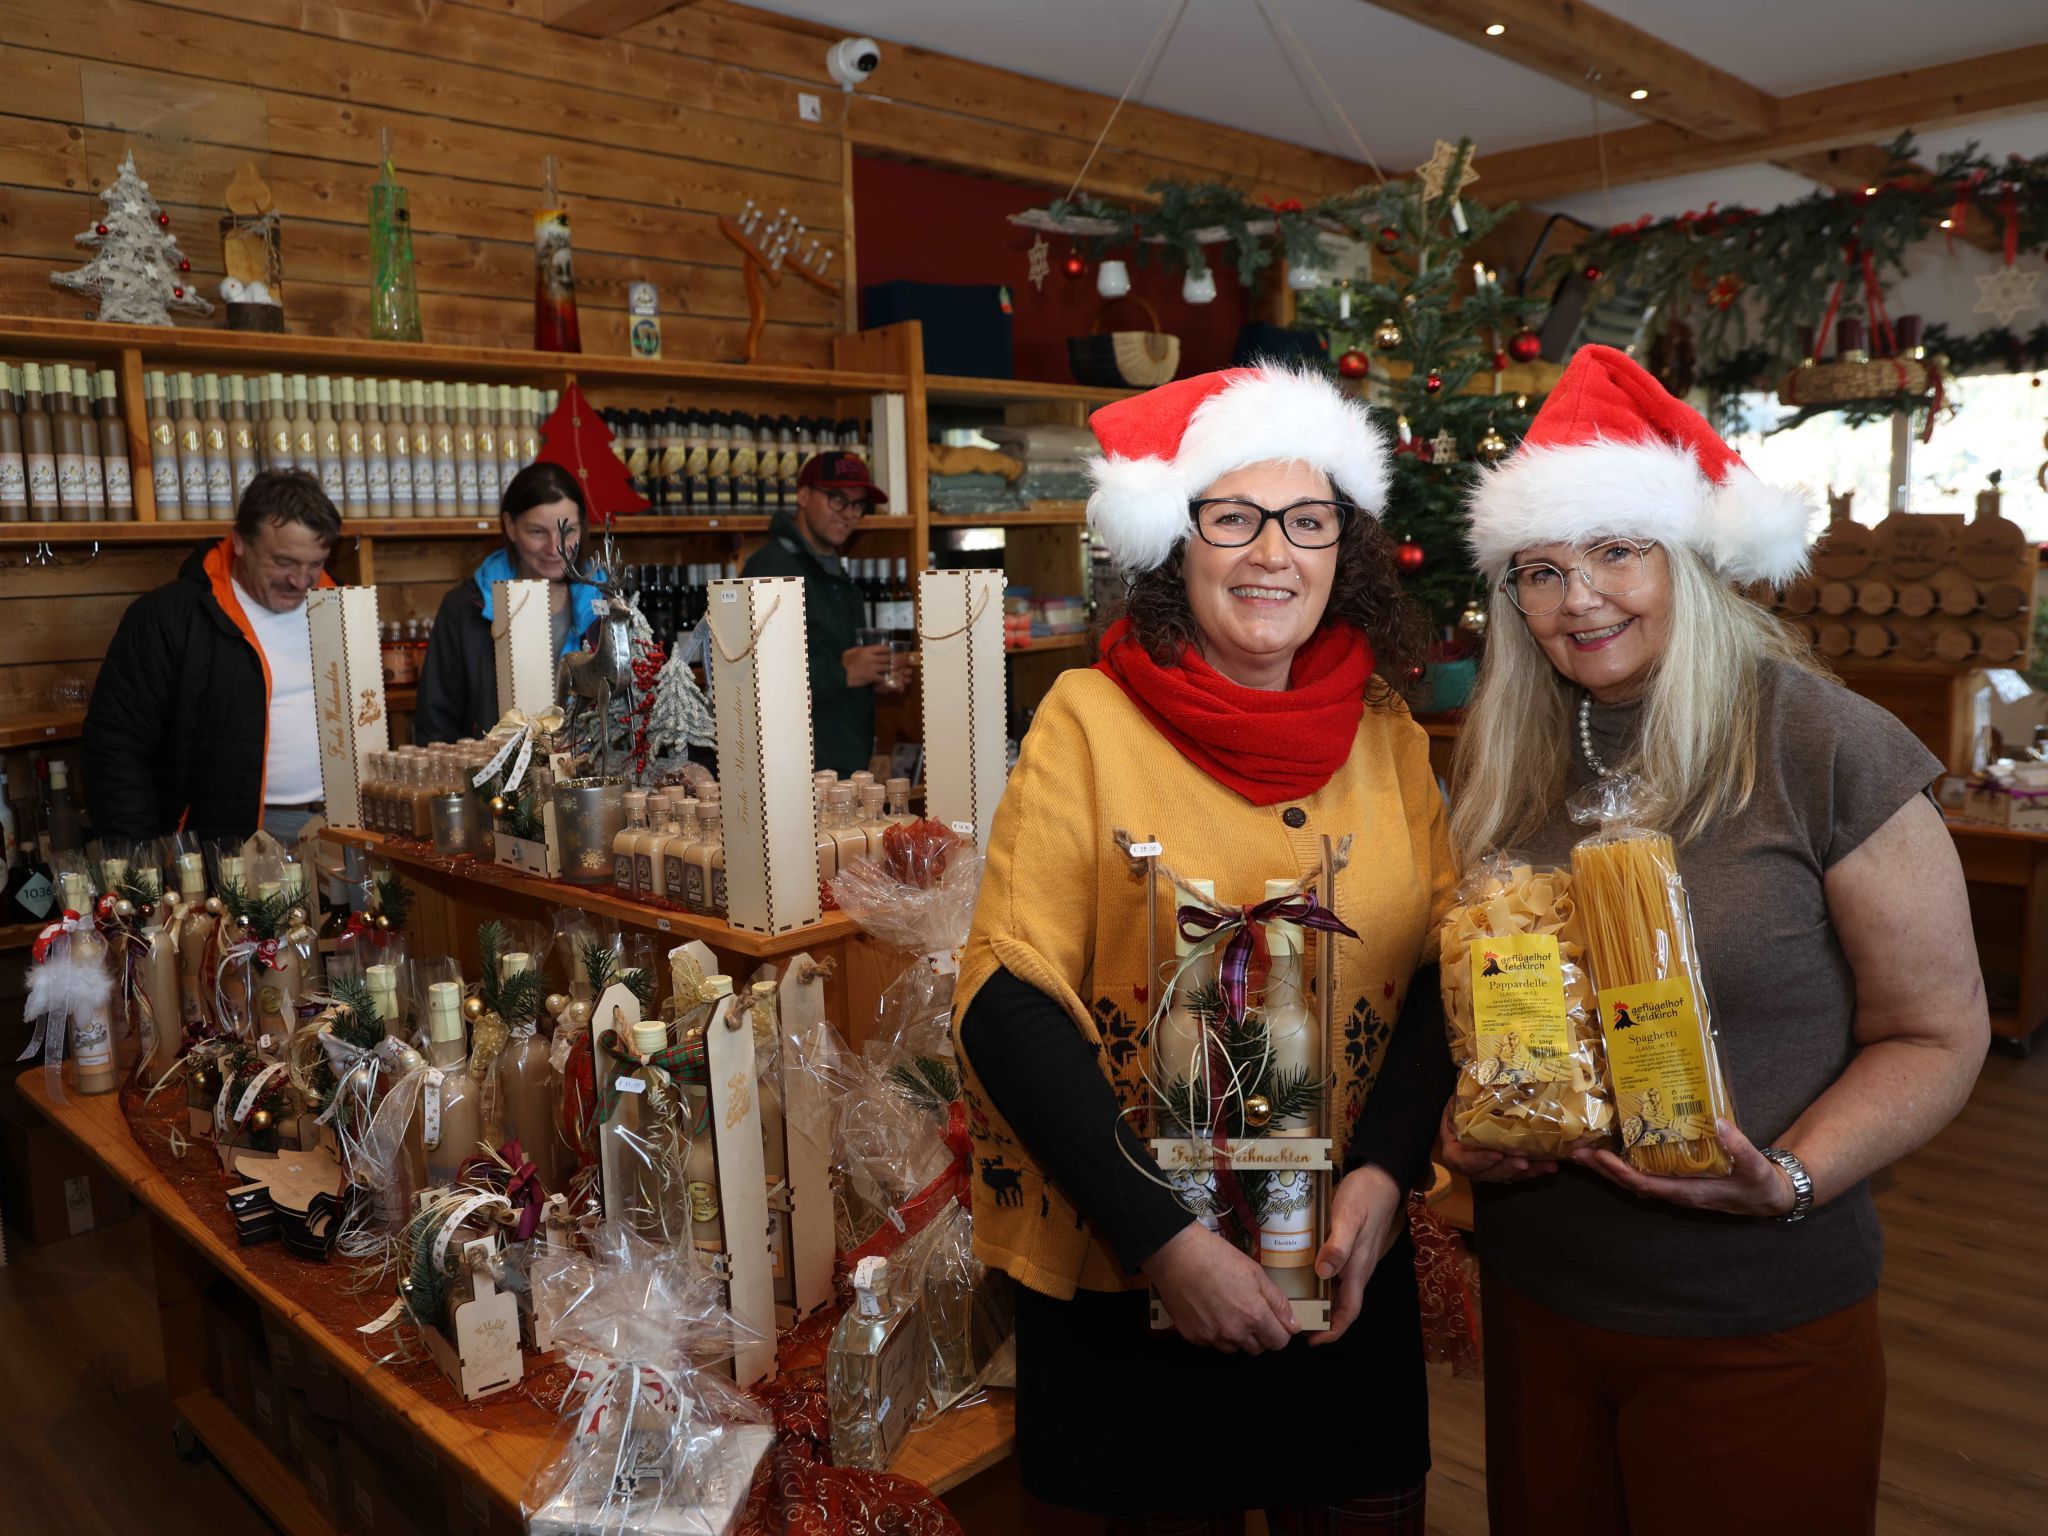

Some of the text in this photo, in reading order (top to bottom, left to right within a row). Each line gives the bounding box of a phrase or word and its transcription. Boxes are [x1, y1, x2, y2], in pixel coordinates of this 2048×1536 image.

[1500, 953, 1552, 964] geflügelhof
[1504, 962, 1545, 971] feldkirch
[1489, 979, 1548, 990] Pappardelle
[1631, 997, 1685, 1016] geflügelhof
[1636, 1009, 1678, 1022] feldkirch
[1628, 1028, 1678, 1046] Spaghetti
[1635, 1044, 1656, 1052] CLASSIC
